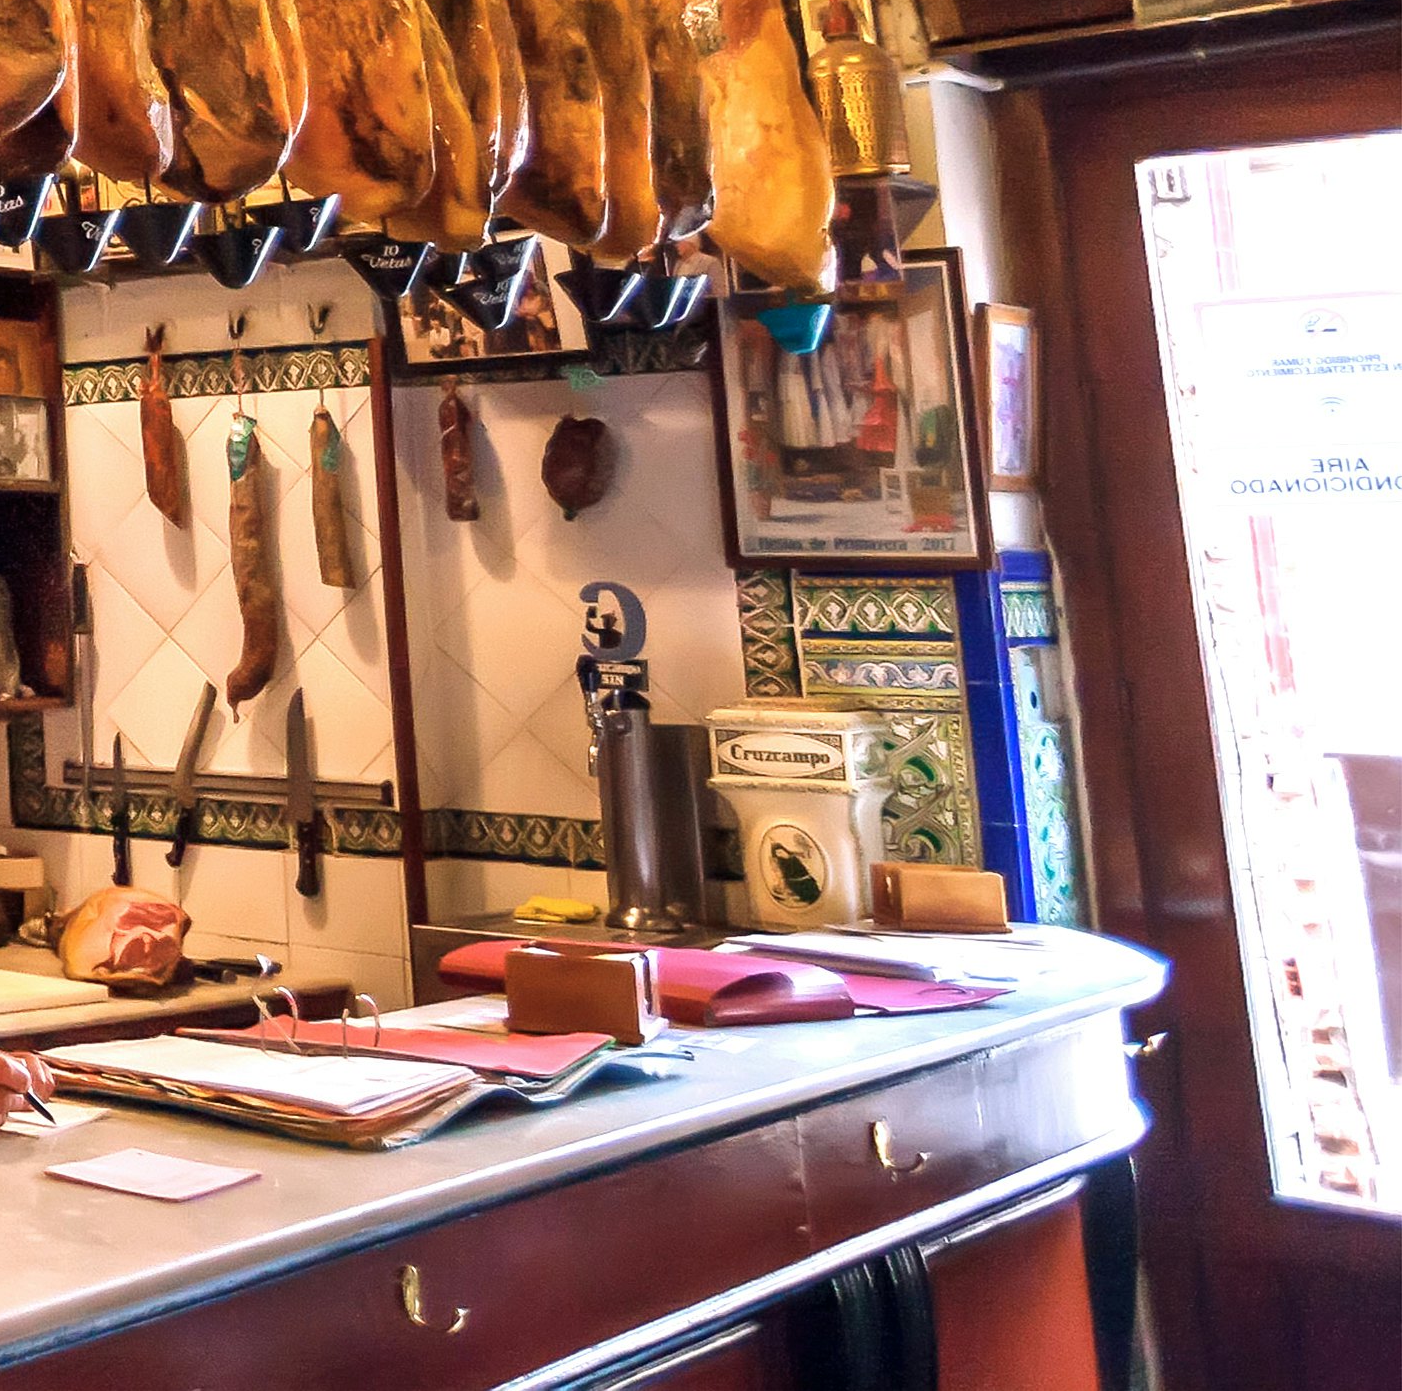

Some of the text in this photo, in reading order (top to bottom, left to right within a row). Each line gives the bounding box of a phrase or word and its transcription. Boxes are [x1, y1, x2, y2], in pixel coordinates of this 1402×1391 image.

[383, 244, 400, 256] 10
[360, 252, 412, 269] Vetas
[730, 743, 831, 769] Cruzcampo
